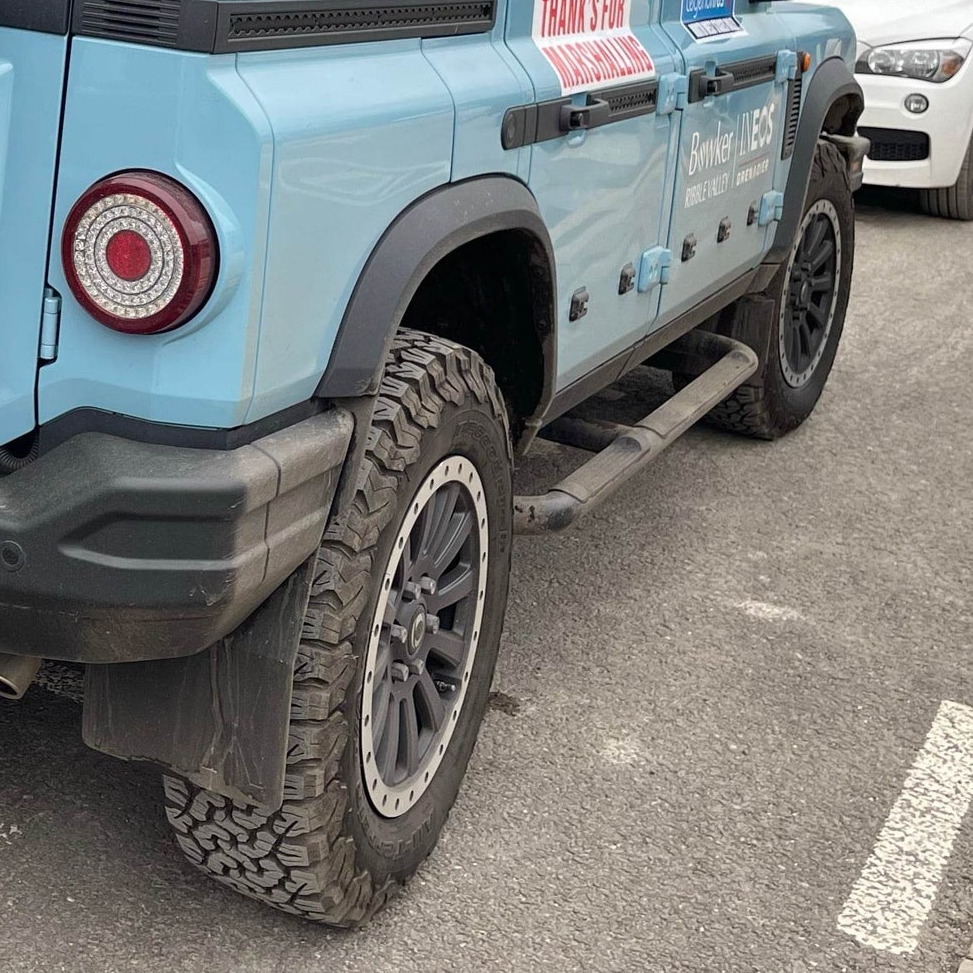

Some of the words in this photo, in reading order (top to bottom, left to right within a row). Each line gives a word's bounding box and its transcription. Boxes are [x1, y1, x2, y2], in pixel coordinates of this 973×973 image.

[541, 35, 653, 89] MARSHALLING
[688, 120, 734, 176] Bowker
[739, 102, 775, 156] INEOS
[707, 172, 730, 199] VALLEY
